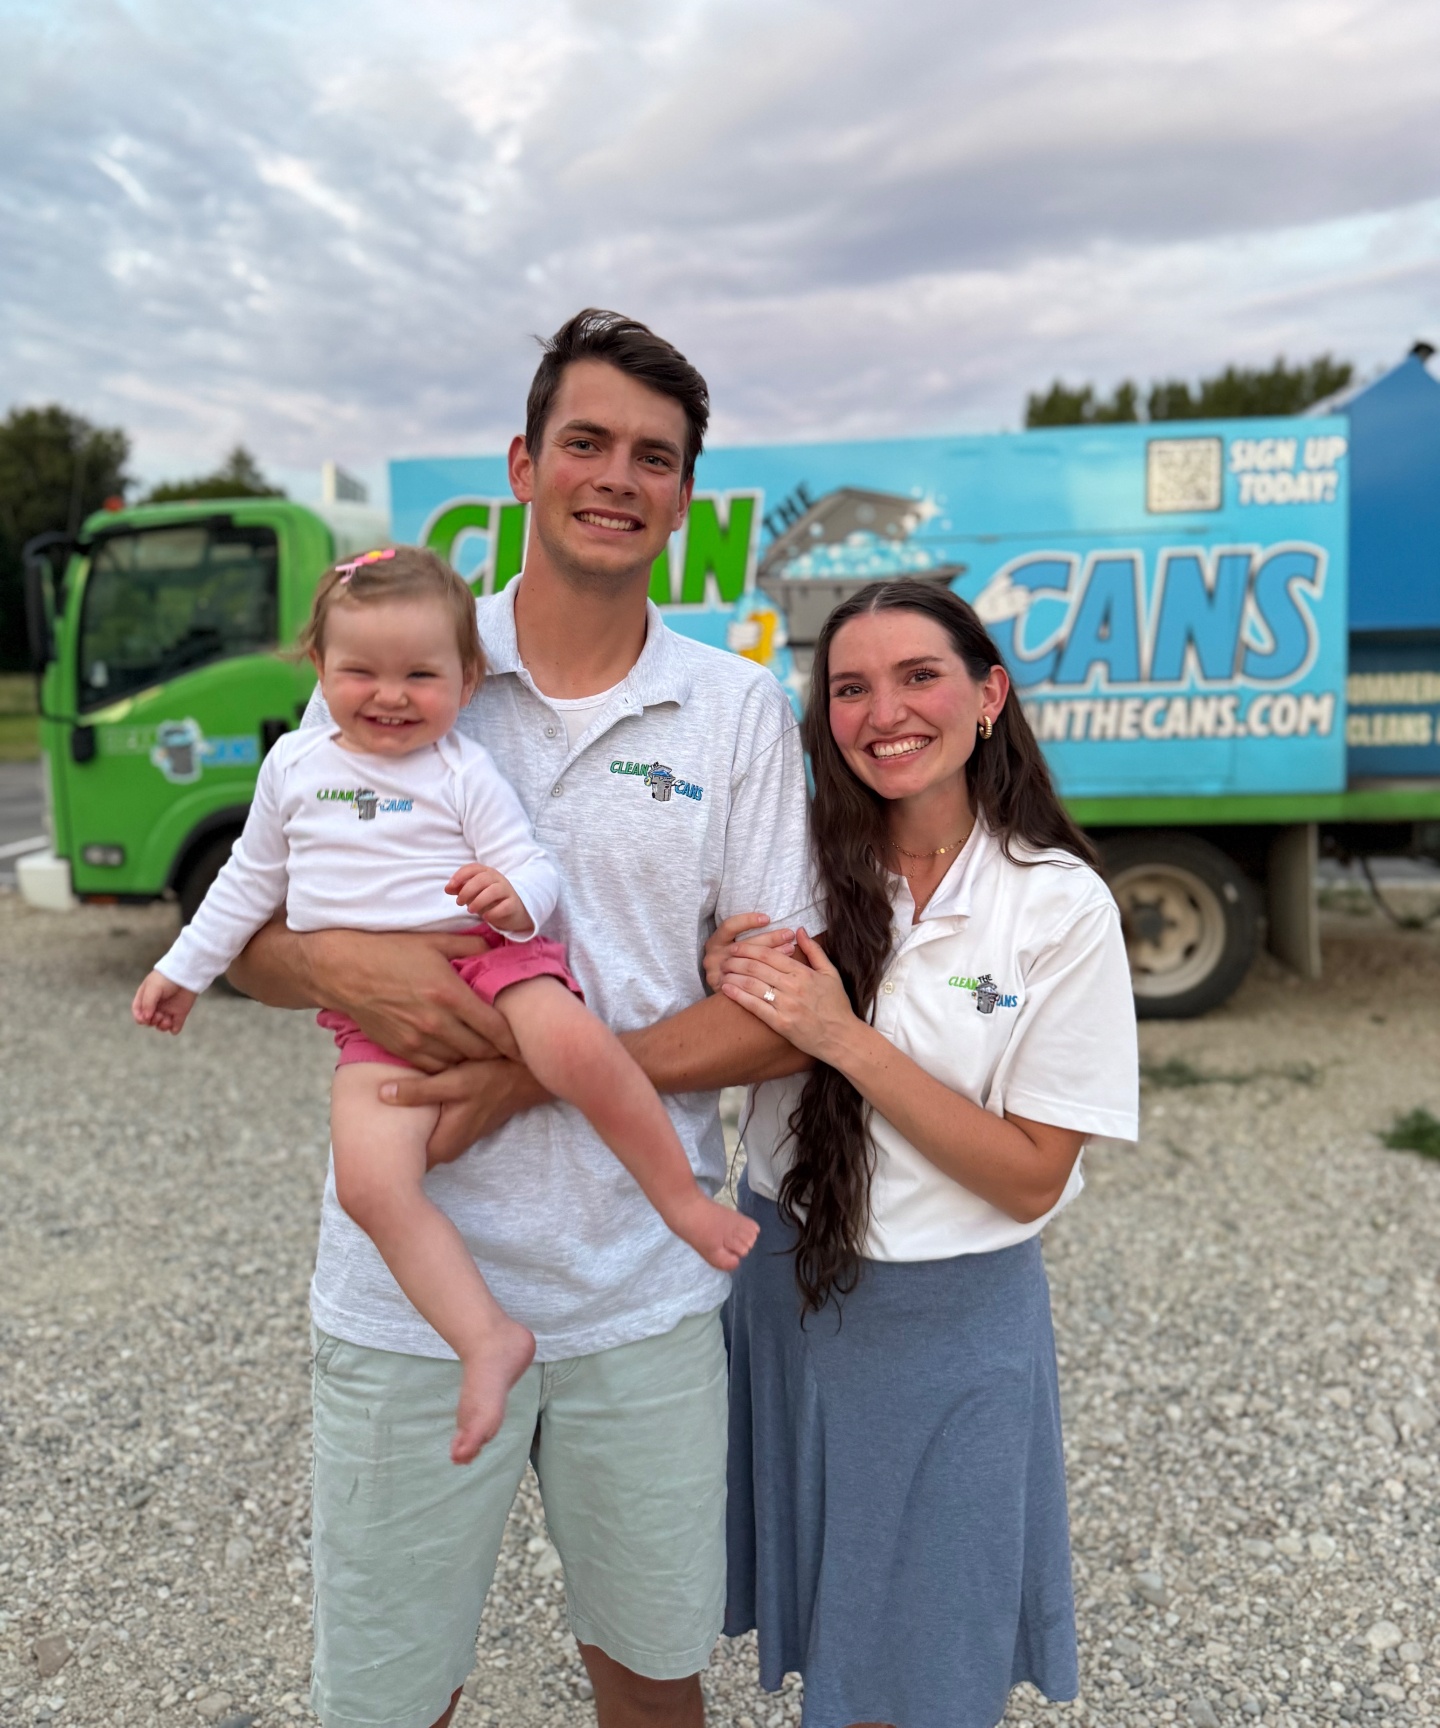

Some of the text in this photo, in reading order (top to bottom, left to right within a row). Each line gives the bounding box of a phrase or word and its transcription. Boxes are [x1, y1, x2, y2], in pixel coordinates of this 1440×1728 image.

[1229, 435, 1347, 473] SIGN UP
[418, 488, 764, 607] CLN
[975, 541, 1328, 692] CANS
[609, 760, 649, 776] CLEAN
[674, 780, 704, 801] CANS
[948, 976, 979, 991] CLEAN
[978, 973, 993, 984] THE
